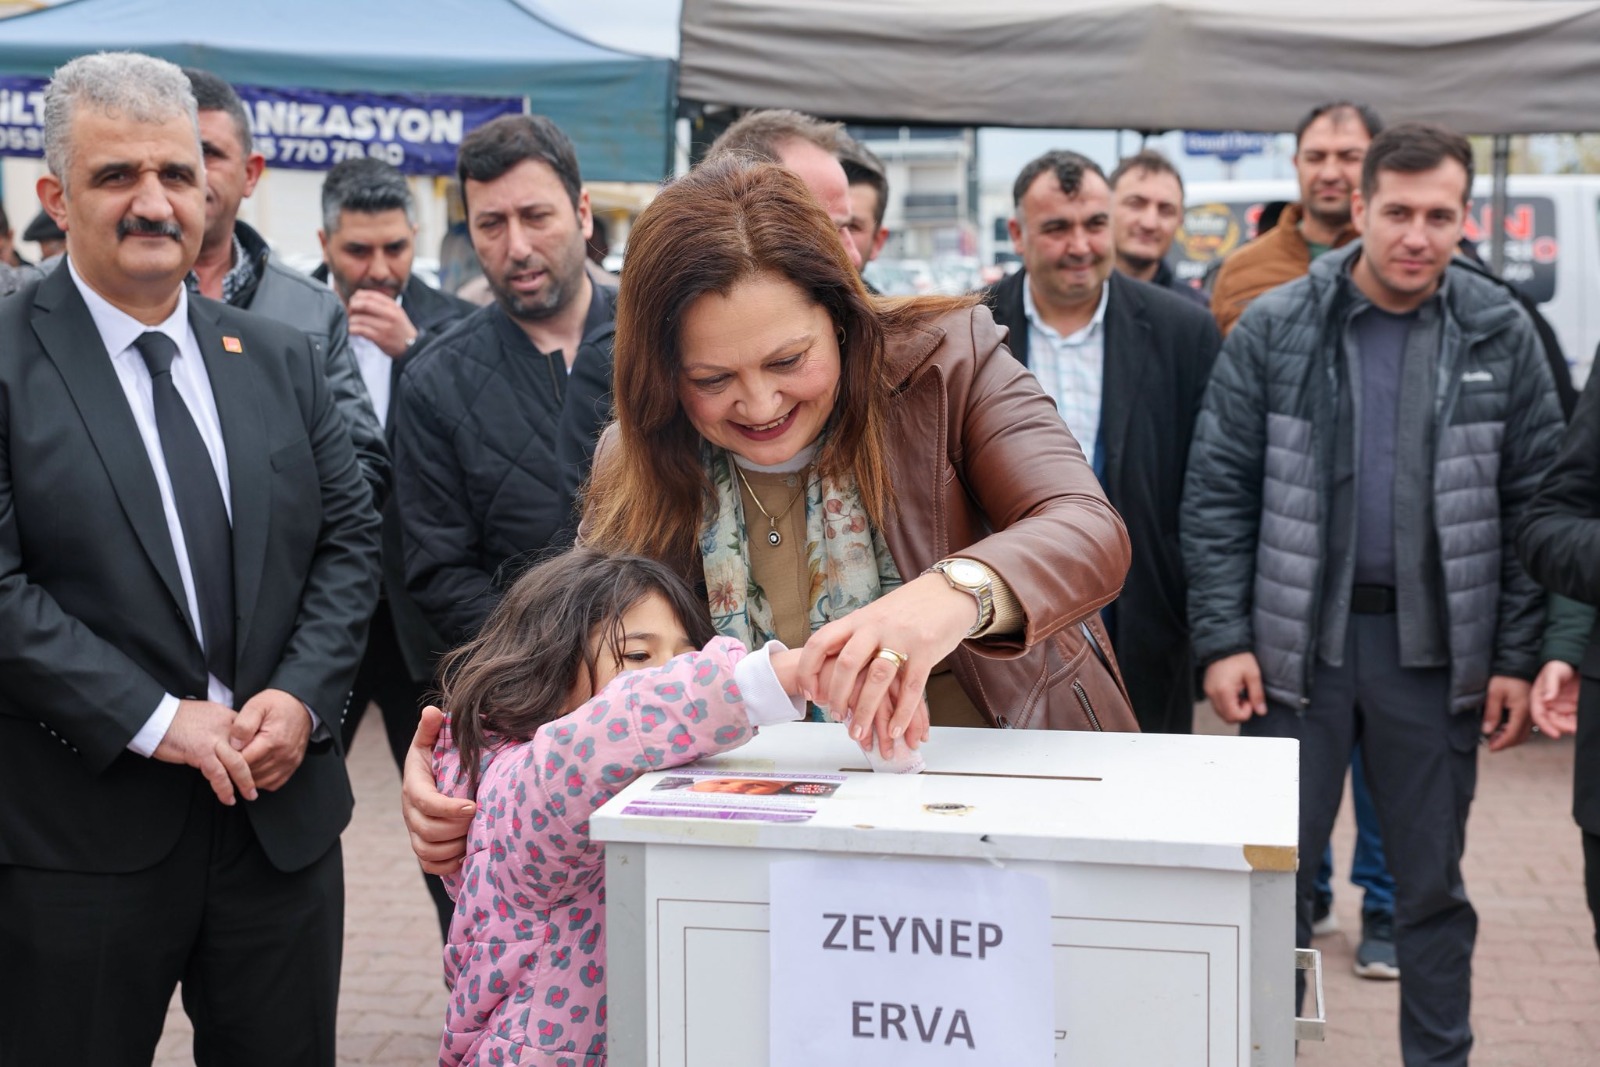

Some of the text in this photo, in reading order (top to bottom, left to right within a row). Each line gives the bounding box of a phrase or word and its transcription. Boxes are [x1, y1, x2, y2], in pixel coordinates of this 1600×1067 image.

[278, 138, 328, 163] 770
[822, 912, 1004, 961] ZEYNEP
[851, 1000, 976, 1050] ERVA
